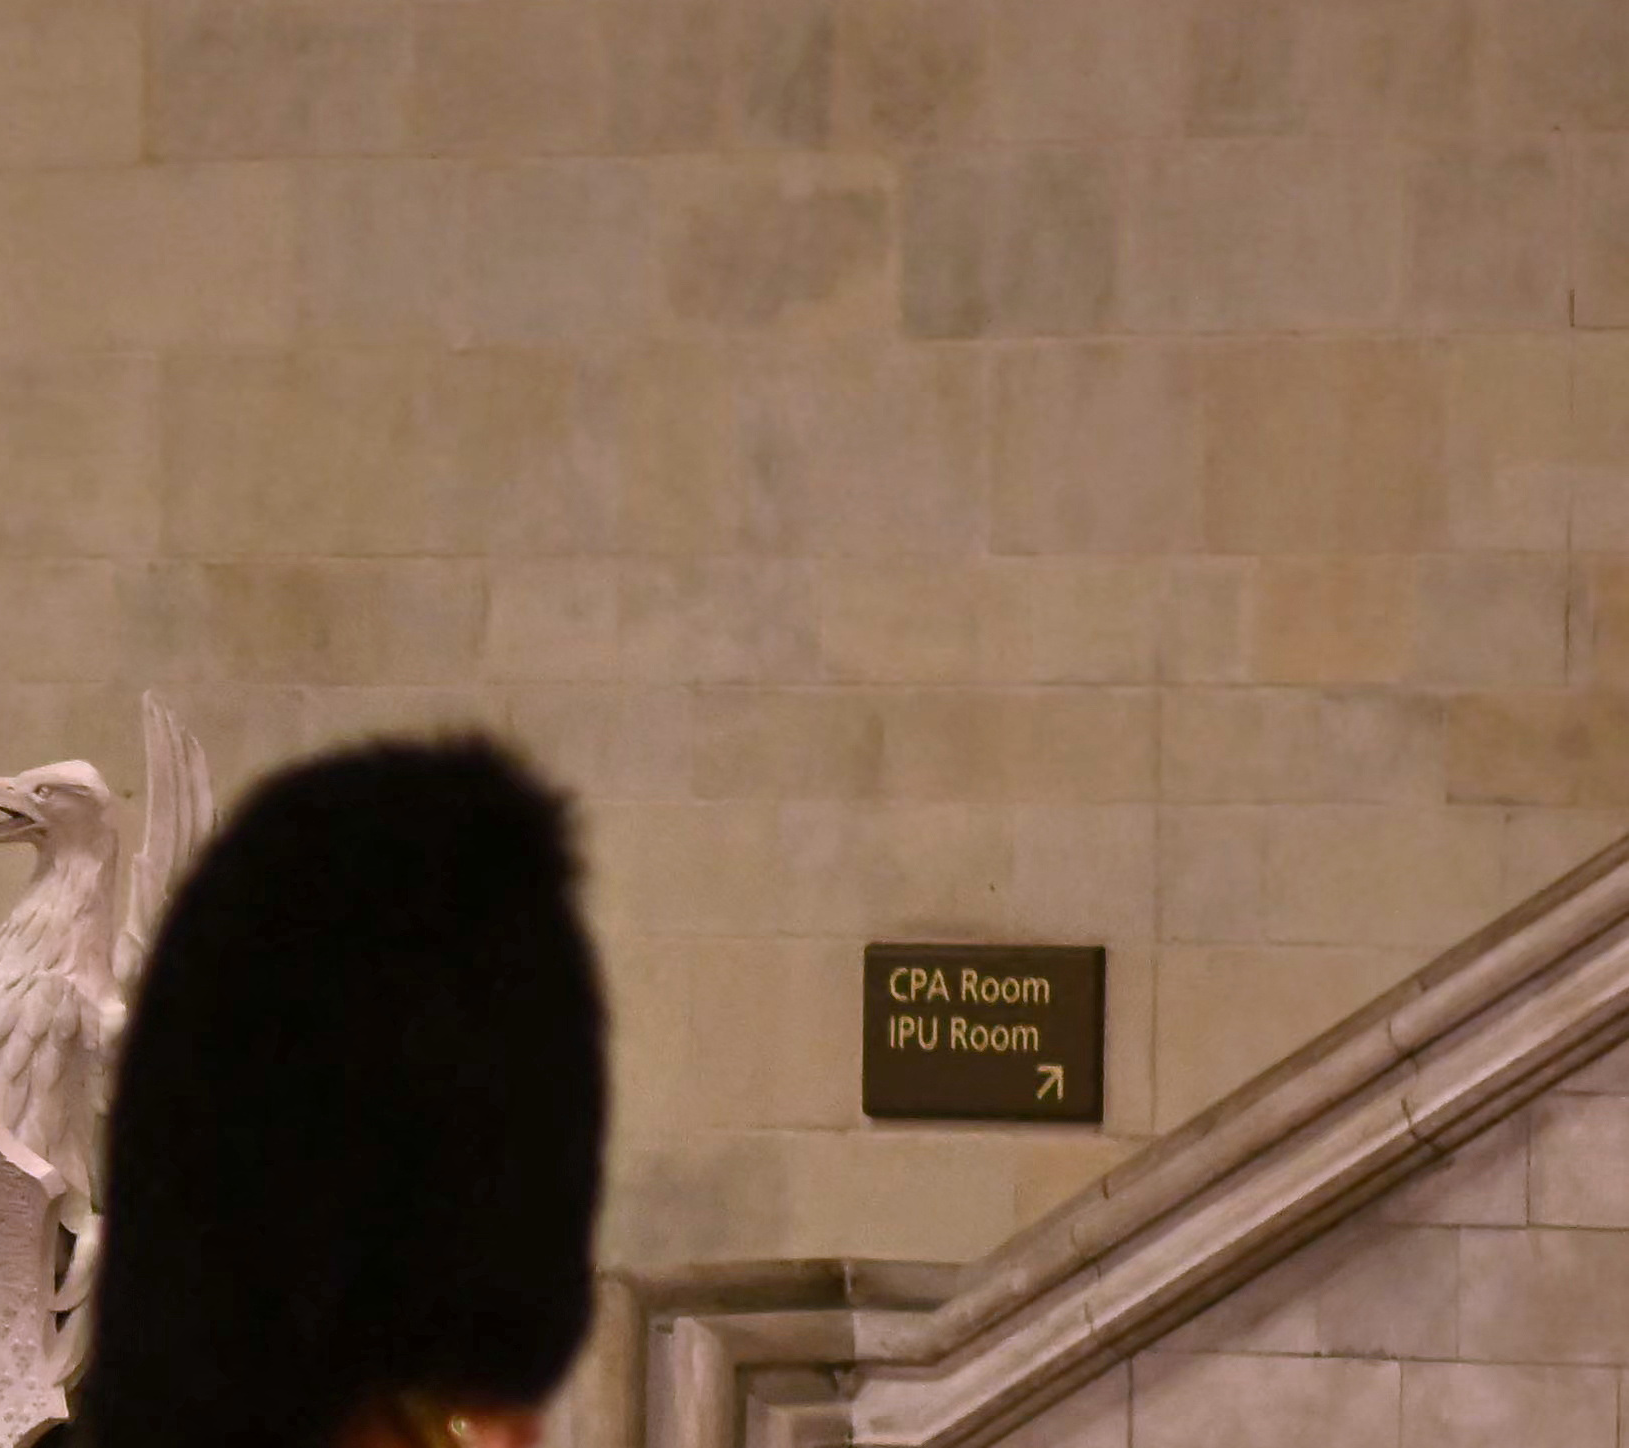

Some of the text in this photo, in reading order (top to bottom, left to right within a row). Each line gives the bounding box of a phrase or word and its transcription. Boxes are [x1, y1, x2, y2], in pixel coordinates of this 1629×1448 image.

[889, 967, 1050, 1004] CPA Room
[889, 1015, 1039, 1051] IPU Room
